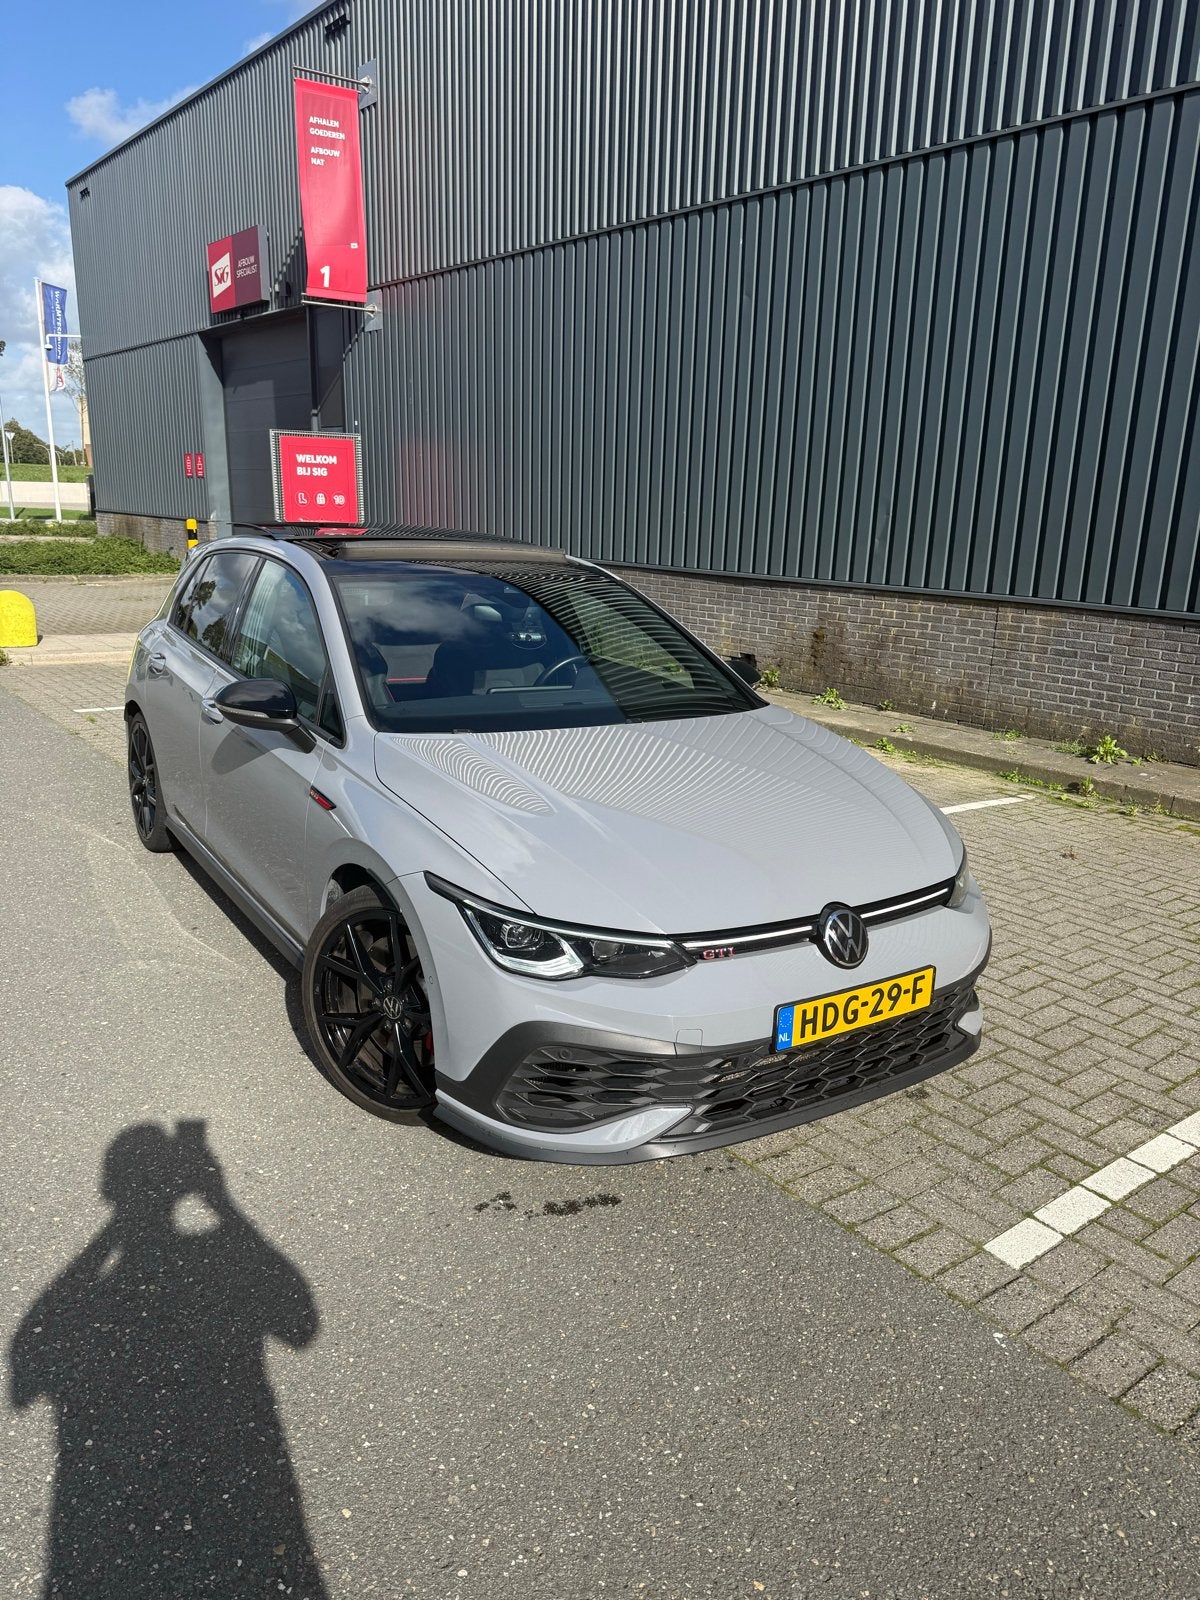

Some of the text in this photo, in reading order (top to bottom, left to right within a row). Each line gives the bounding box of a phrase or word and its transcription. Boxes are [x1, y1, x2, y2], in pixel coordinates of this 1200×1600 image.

[309, 116, 339, 128] AFHALEN
[310, 128, 345, 140] GOEDEREN
[311, 146, 340, 157] AFBOUW
[311, 157, 325, 166] NAT
[319, 265, 331, 288] 1
[296, 454, 337, 464] WELKOM
[296, 466, 328, 476] BIJ SIG
[703, 947, 734, 960] GTI
[799, 974, 926, 1039] HDG-29-F
[778, 1032, 790, 1043] NL
